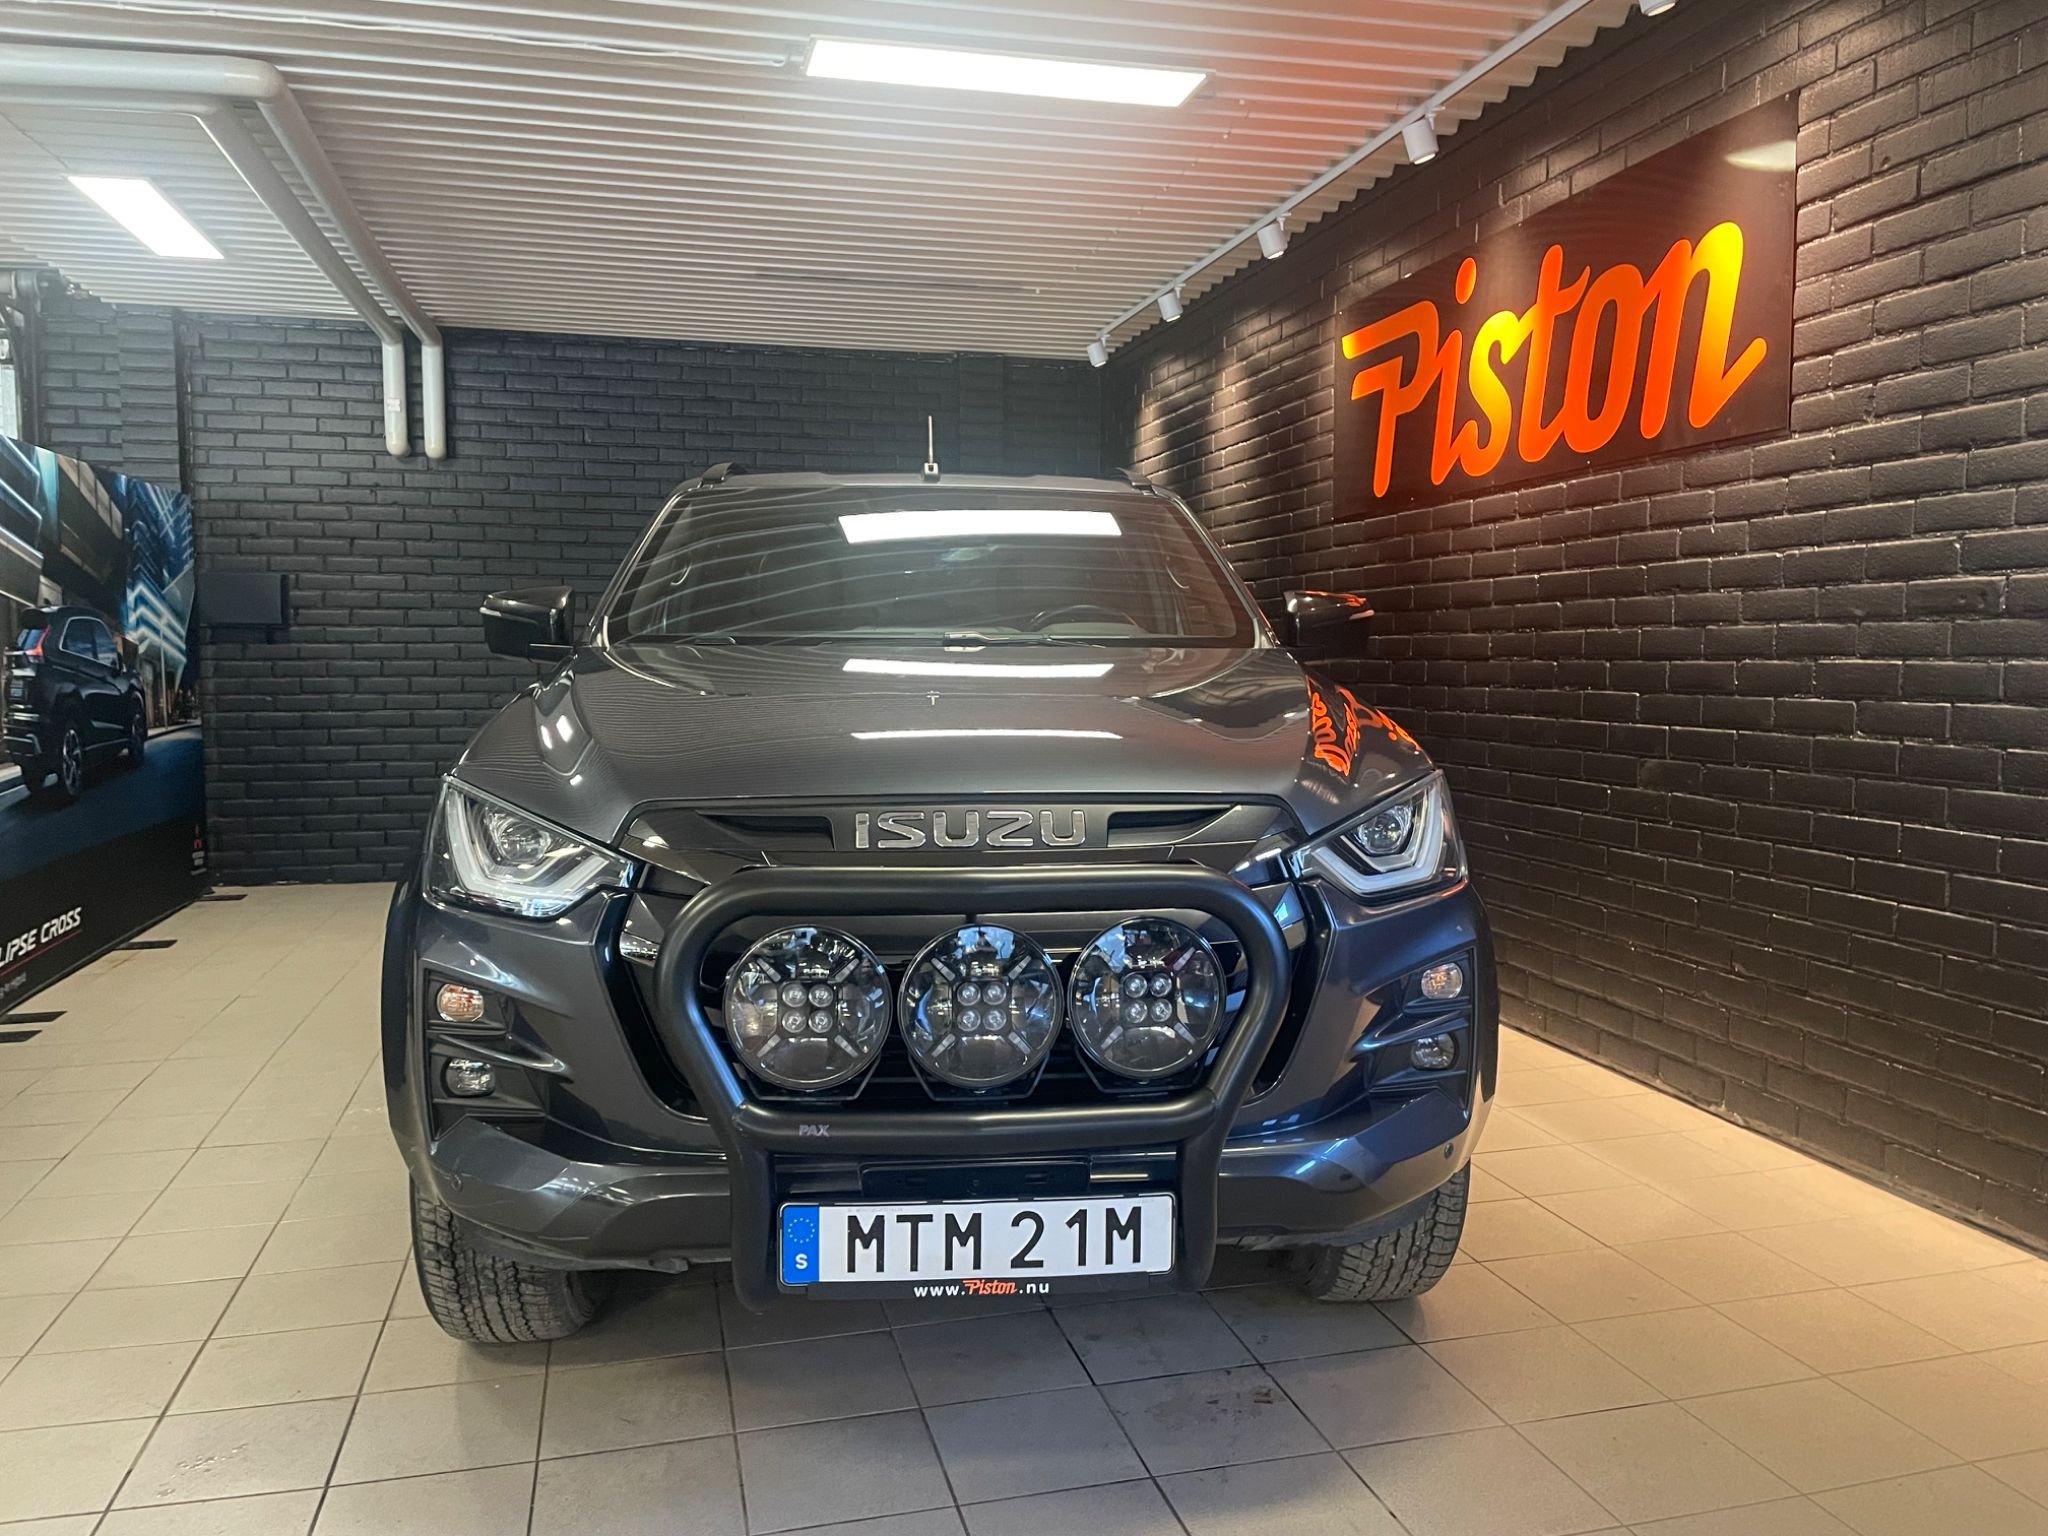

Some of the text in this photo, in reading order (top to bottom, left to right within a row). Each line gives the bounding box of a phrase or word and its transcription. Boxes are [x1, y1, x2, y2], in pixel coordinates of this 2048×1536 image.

[1342, 222, 1767, 498] Piston
[855, 810, 1087, 850] ISUZU
[41, 907, 82, 943] CROSS
[799, 1124, 830, 1137] PAX
[847, 1206, 1143, 1273] MTM 21M
[794, 1253, 808, 1270] S
[913, 1279, 1050, 1298] www.Piston.nu
